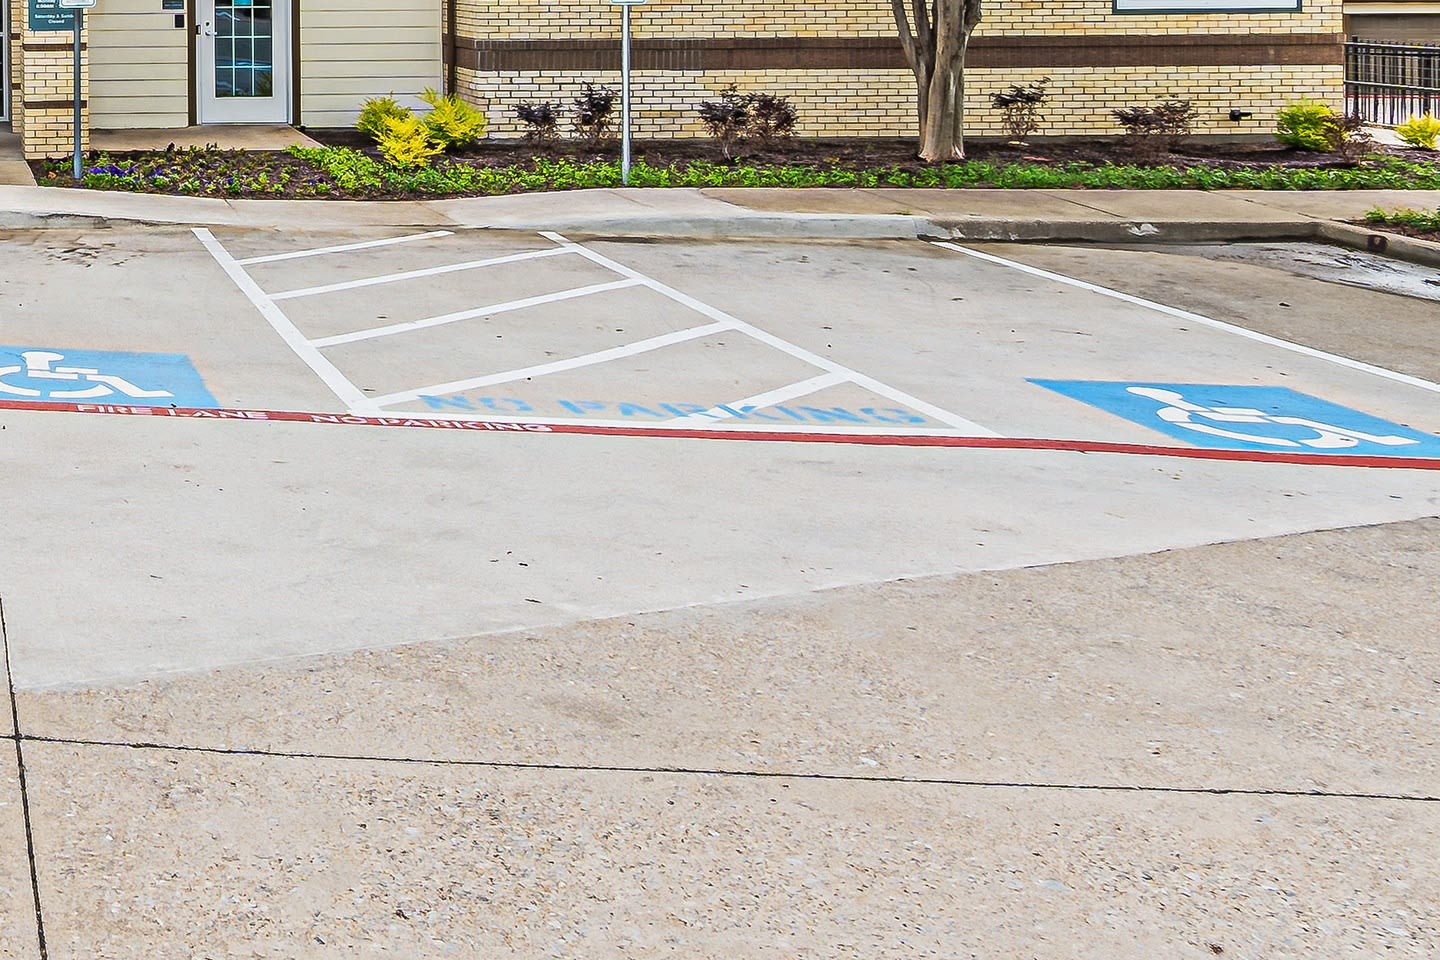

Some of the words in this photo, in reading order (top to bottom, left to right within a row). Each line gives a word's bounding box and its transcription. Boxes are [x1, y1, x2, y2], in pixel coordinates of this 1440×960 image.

[76, 405, 152, 414] FIRE
[166, 409, 269, 419] LANE
[310, 415, 368, 424] NO
[380, 417, 553, 432] PARKING
[417, 394, 534, 412] NO
[556, 399, 928, 424] PARKING
